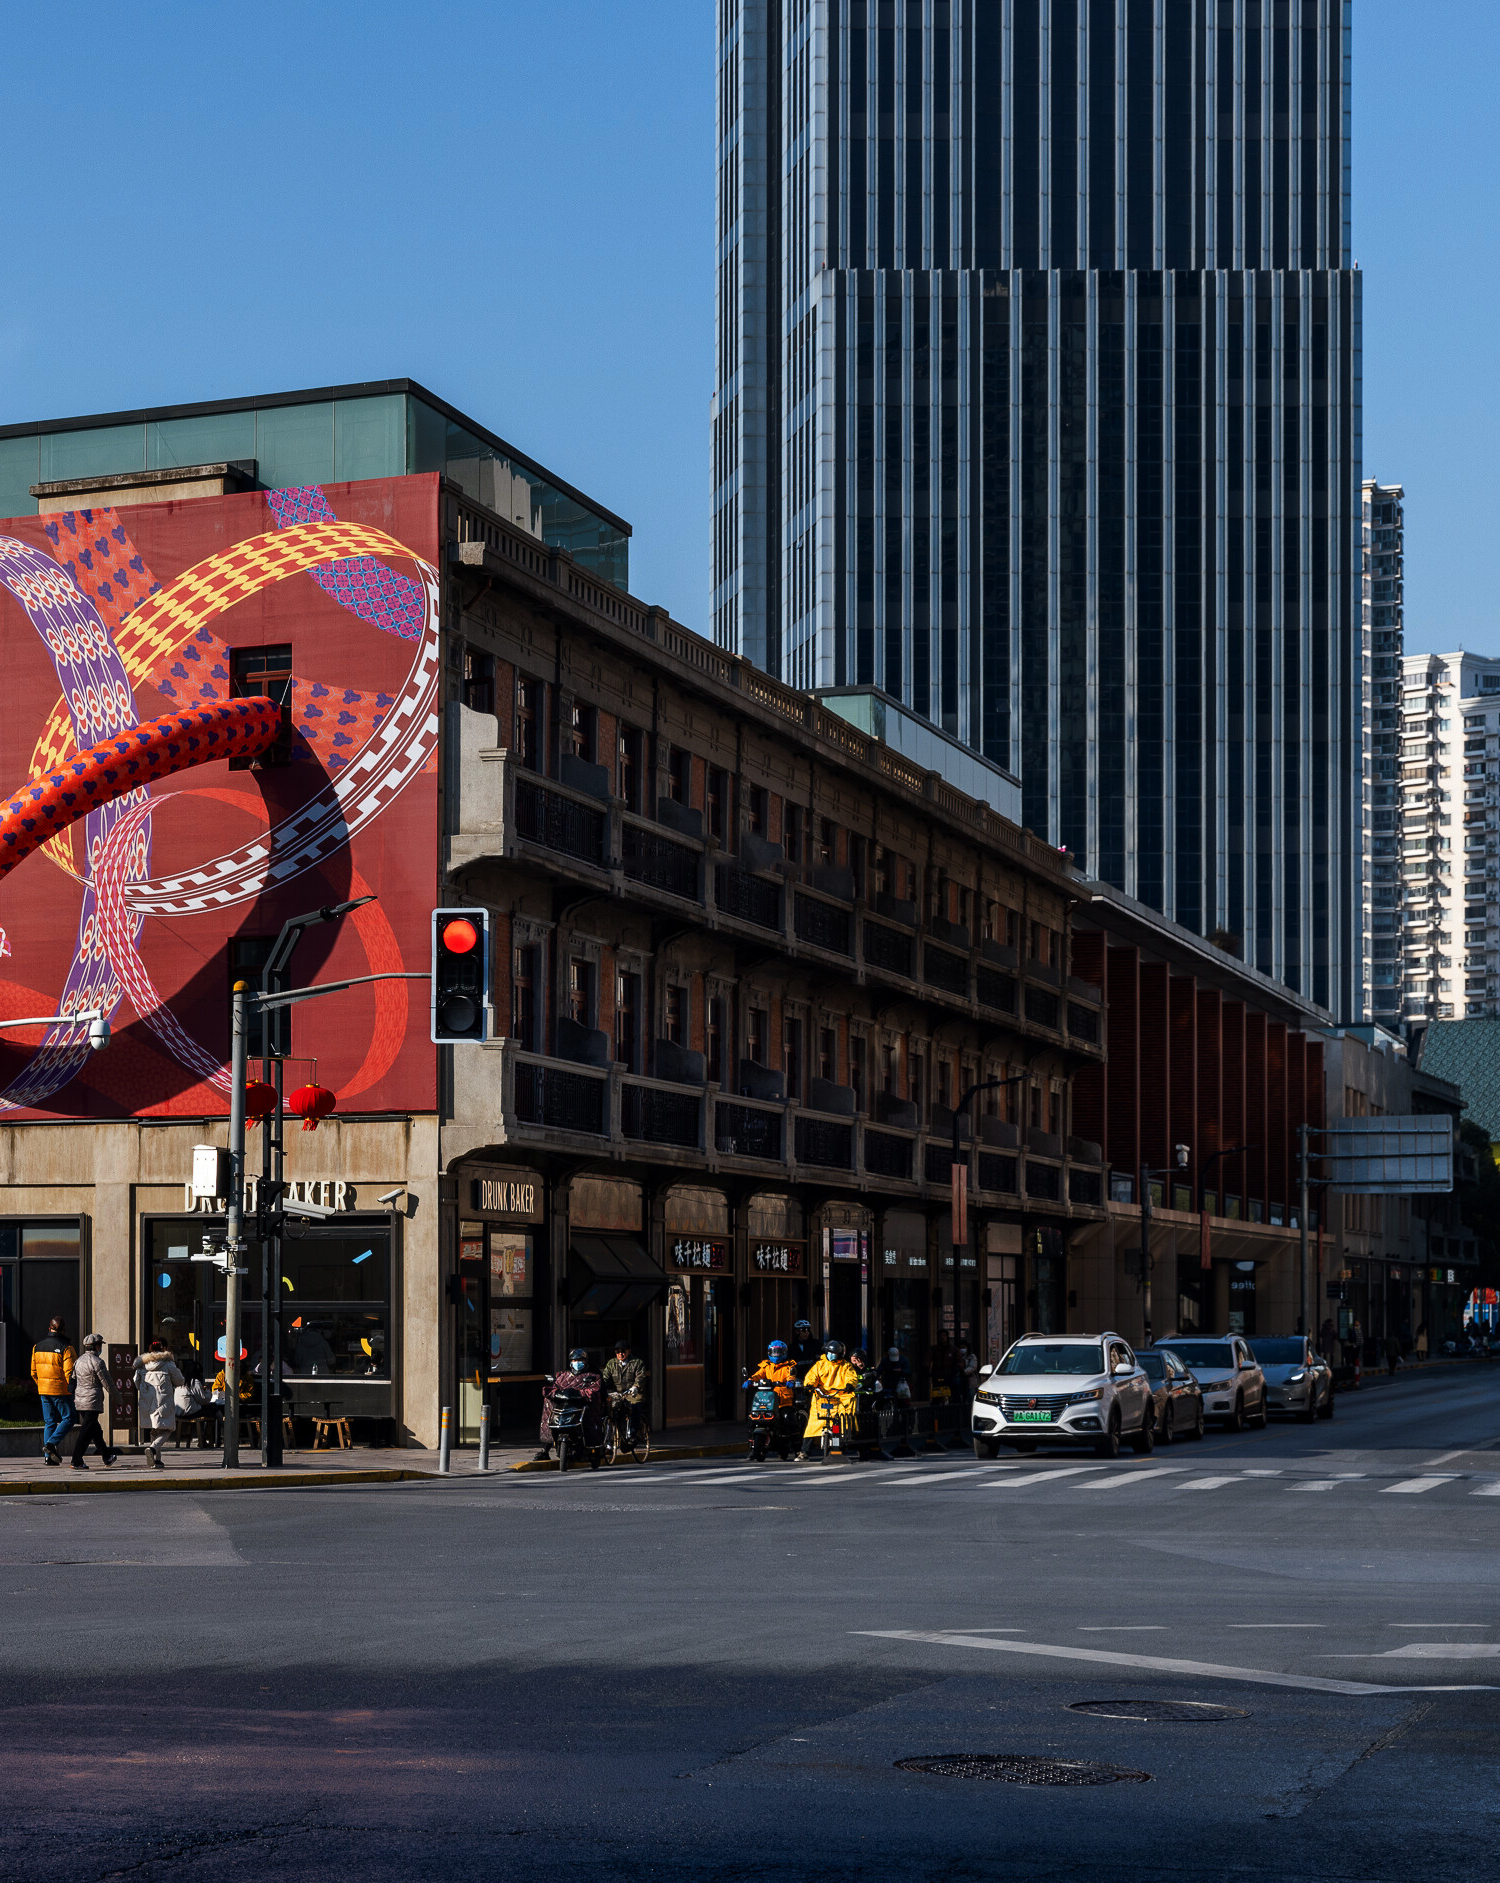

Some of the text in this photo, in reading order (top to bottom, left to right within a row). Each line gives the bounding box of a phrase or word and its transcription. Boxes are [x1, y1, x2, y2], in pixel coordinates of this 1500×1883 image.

[270, 1180, 347, 1212] AKER
[482, 1179, 534, 1214] DRUNK BAKER
[674, 1239, 711, 1268] 味千拉麵
[756, 1244, 789, 1271] 味千拉麵
